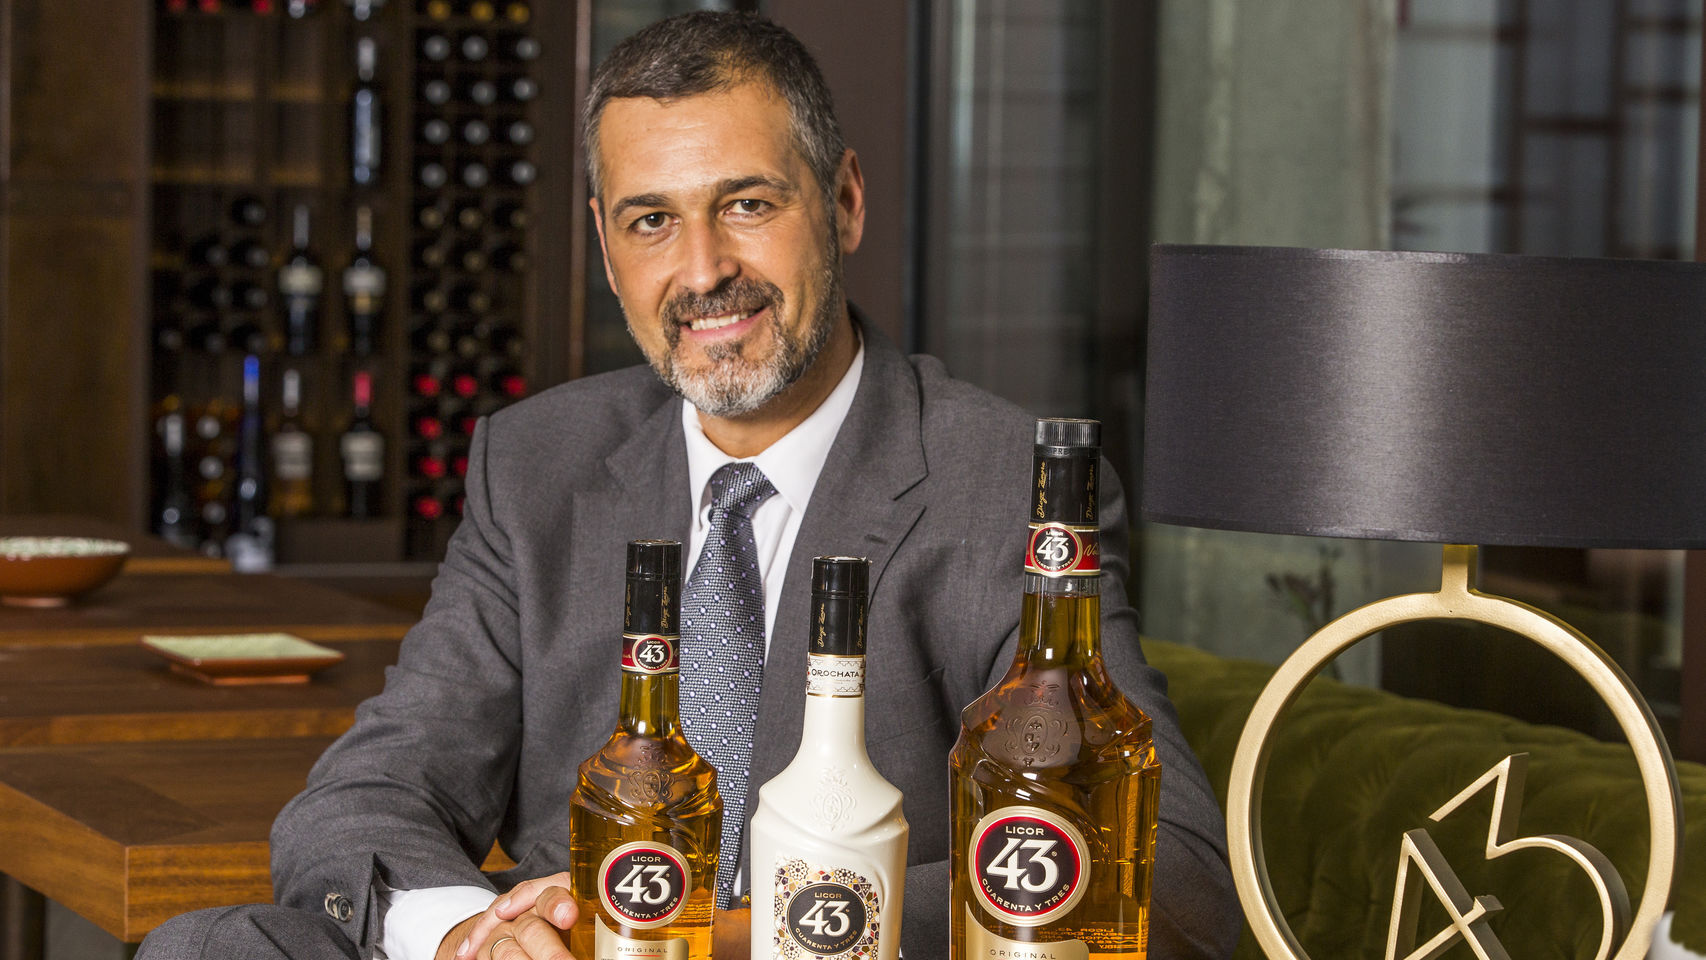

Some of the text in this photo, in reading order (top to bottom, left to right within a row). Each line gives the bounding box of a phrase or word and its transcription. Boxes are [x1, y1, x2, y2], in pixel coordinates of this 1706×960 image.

[1036, 536, 1069, 562] 43
[639, 645, 665, 663] 43
[811, 668, 860, 678] OROCHATA
[1005, 825, 1045, 836] LICOR
[631, 855, 662, 863] LICOR
[986, 837, 1059, 893] 43
[614, 864, 672, 906] 43
[982, 878, 1071, 912] CUARENTA Y TRES
[611, 894, 652, 920] CUARENTA
[652, 911, 659, 919] Y
[660, 897, 679, 915] TRES
[798, 900, 851, 937] 43
[617, 946, 669, 954] ORIGINAL
[795, 927, 832, 950] CUARENTA
[839, 929, 858, 947] TRES
[990, 949, 1057, 960] ORIGINAL
